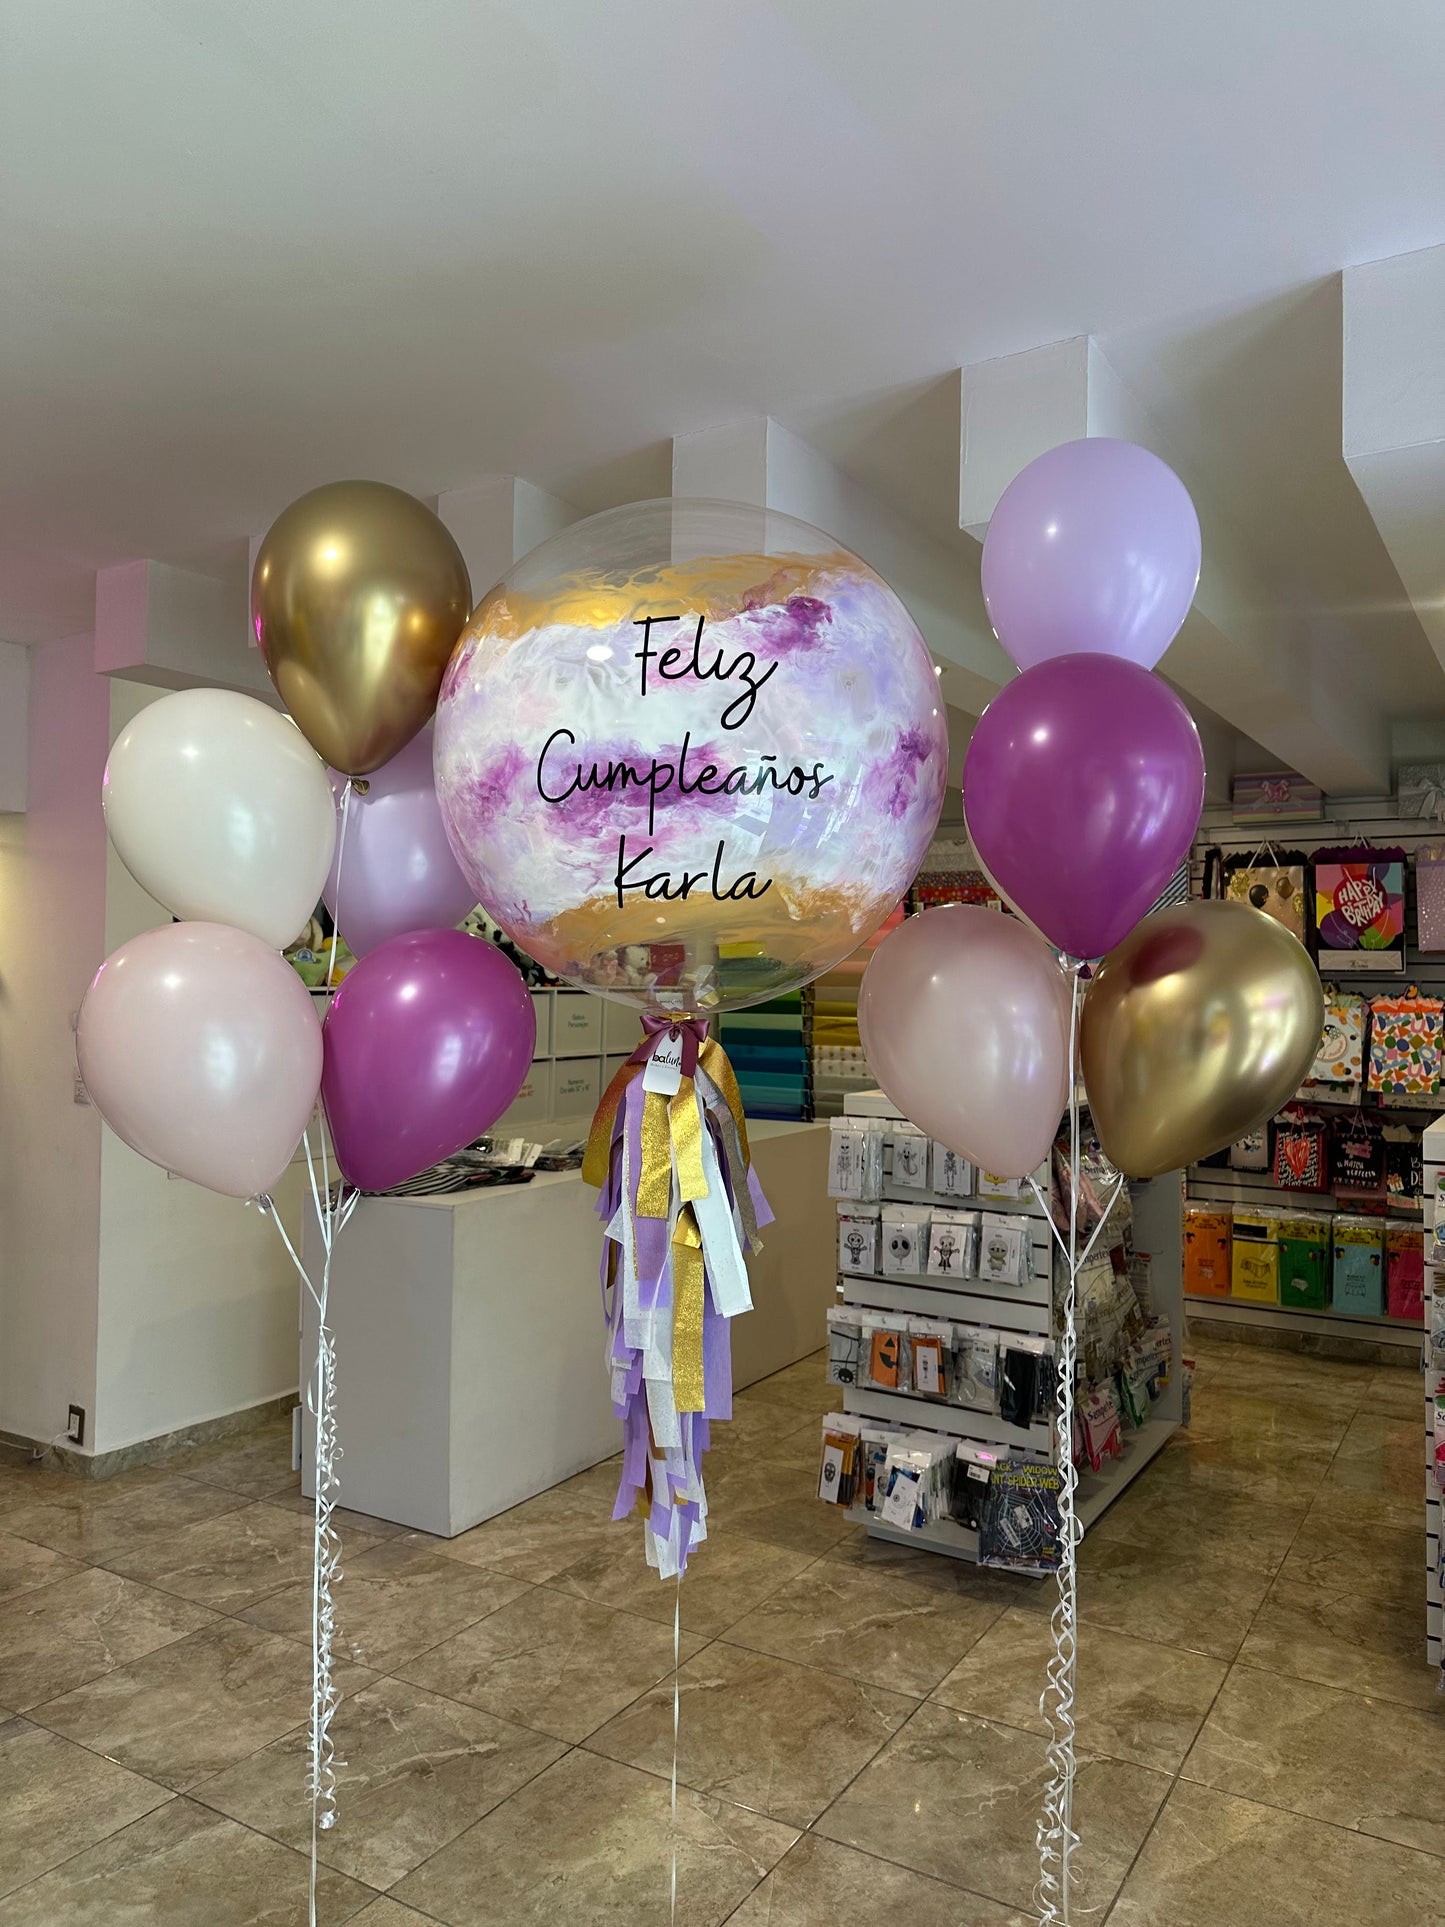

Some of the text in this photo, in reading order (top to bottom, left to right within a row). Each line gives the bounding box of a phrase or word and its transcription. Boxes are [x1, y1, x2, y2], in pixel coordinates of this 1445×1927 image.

[633, 615, 779, 730] Feliz
[537, 728, 835, 836] Cumpleaños
[613, 834, 773, 909] Karla
[1337, 877, 1379, 904] HAPPY
[1022, 1464, 1058, 1476] WIDOW
